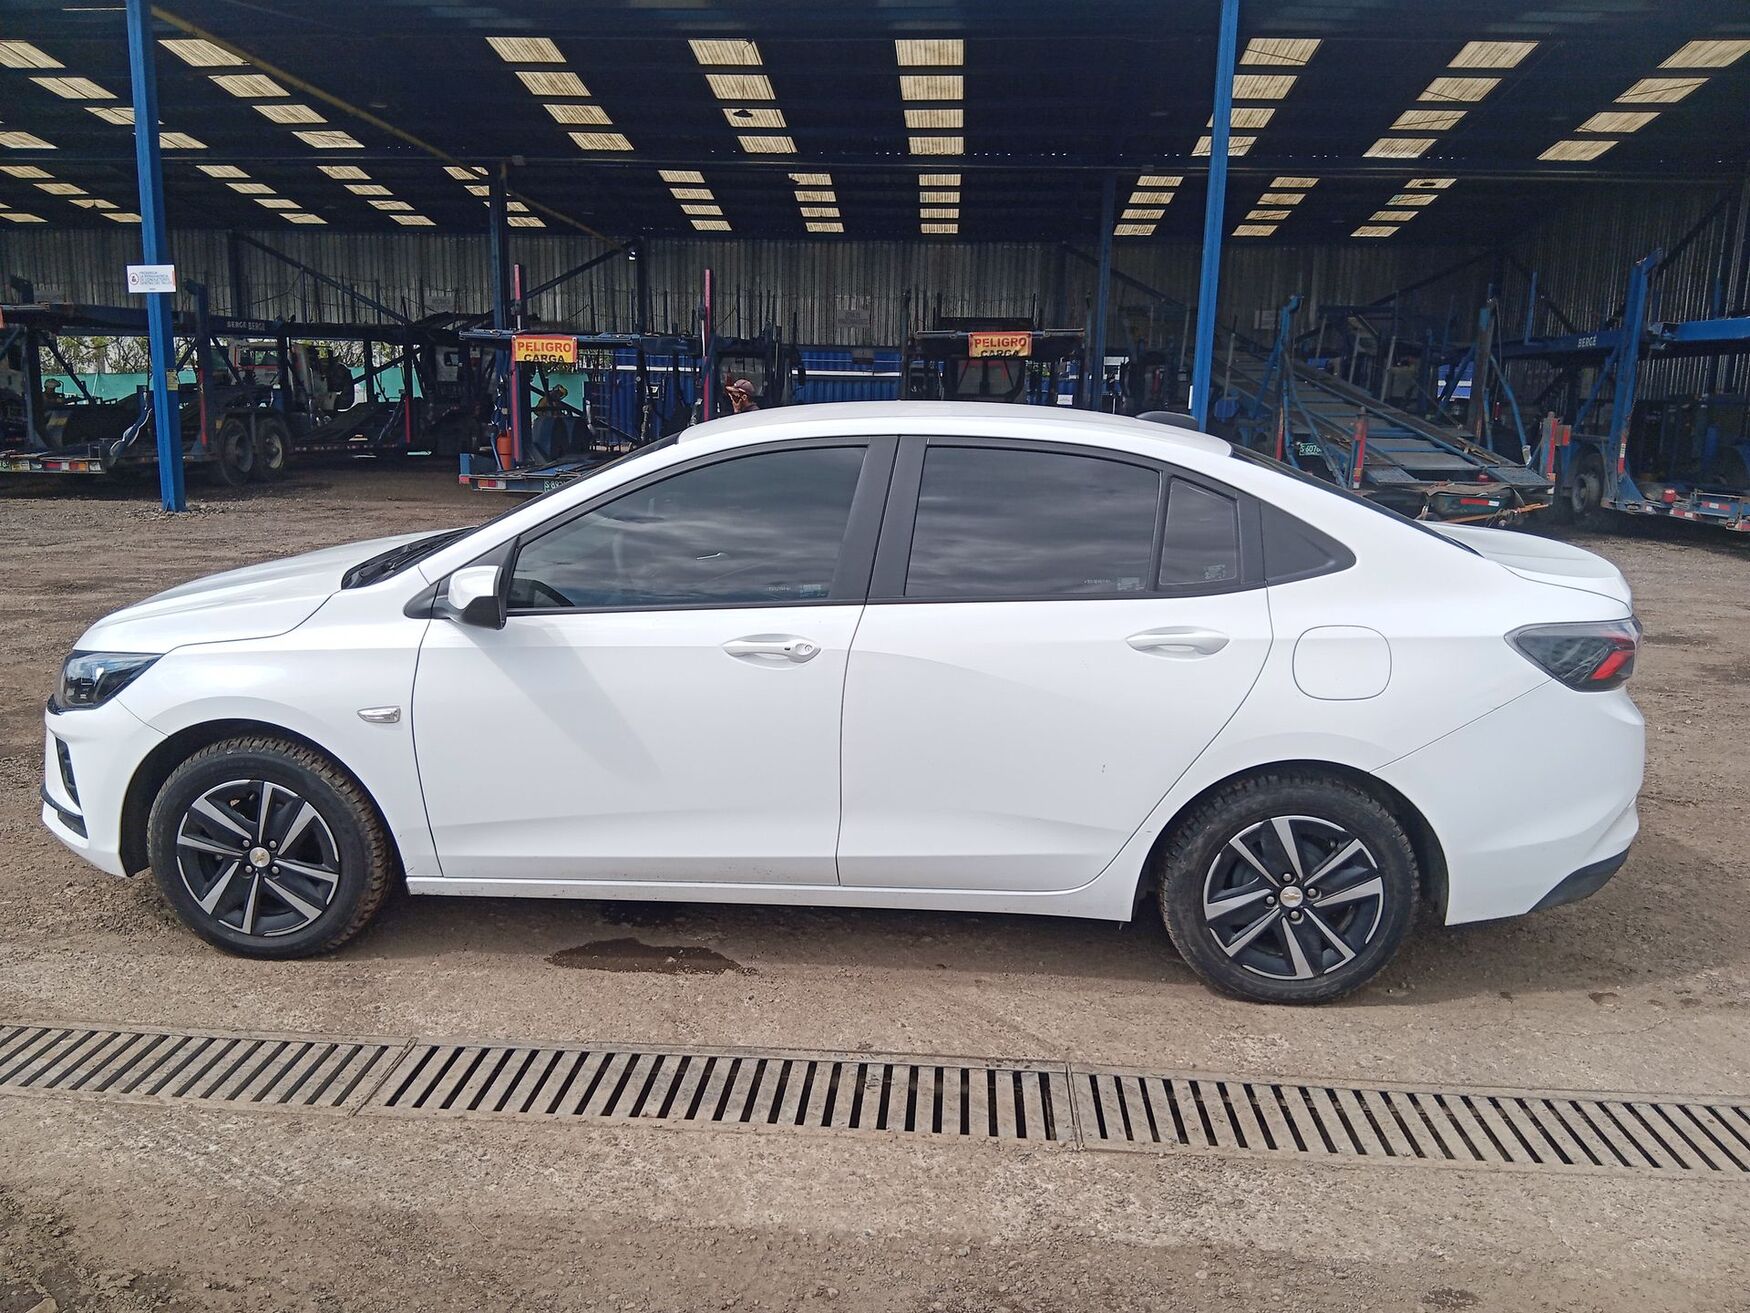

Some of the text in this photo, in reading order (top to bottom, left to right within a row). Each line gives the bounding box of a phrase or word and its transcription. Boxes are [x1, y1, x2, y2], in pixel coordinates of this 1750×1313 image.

[517, 341, 572, 353] PELIGRO
[974, 337, 1027, 348] PELIGRO
[524, 353, 565, 363] CARGA
